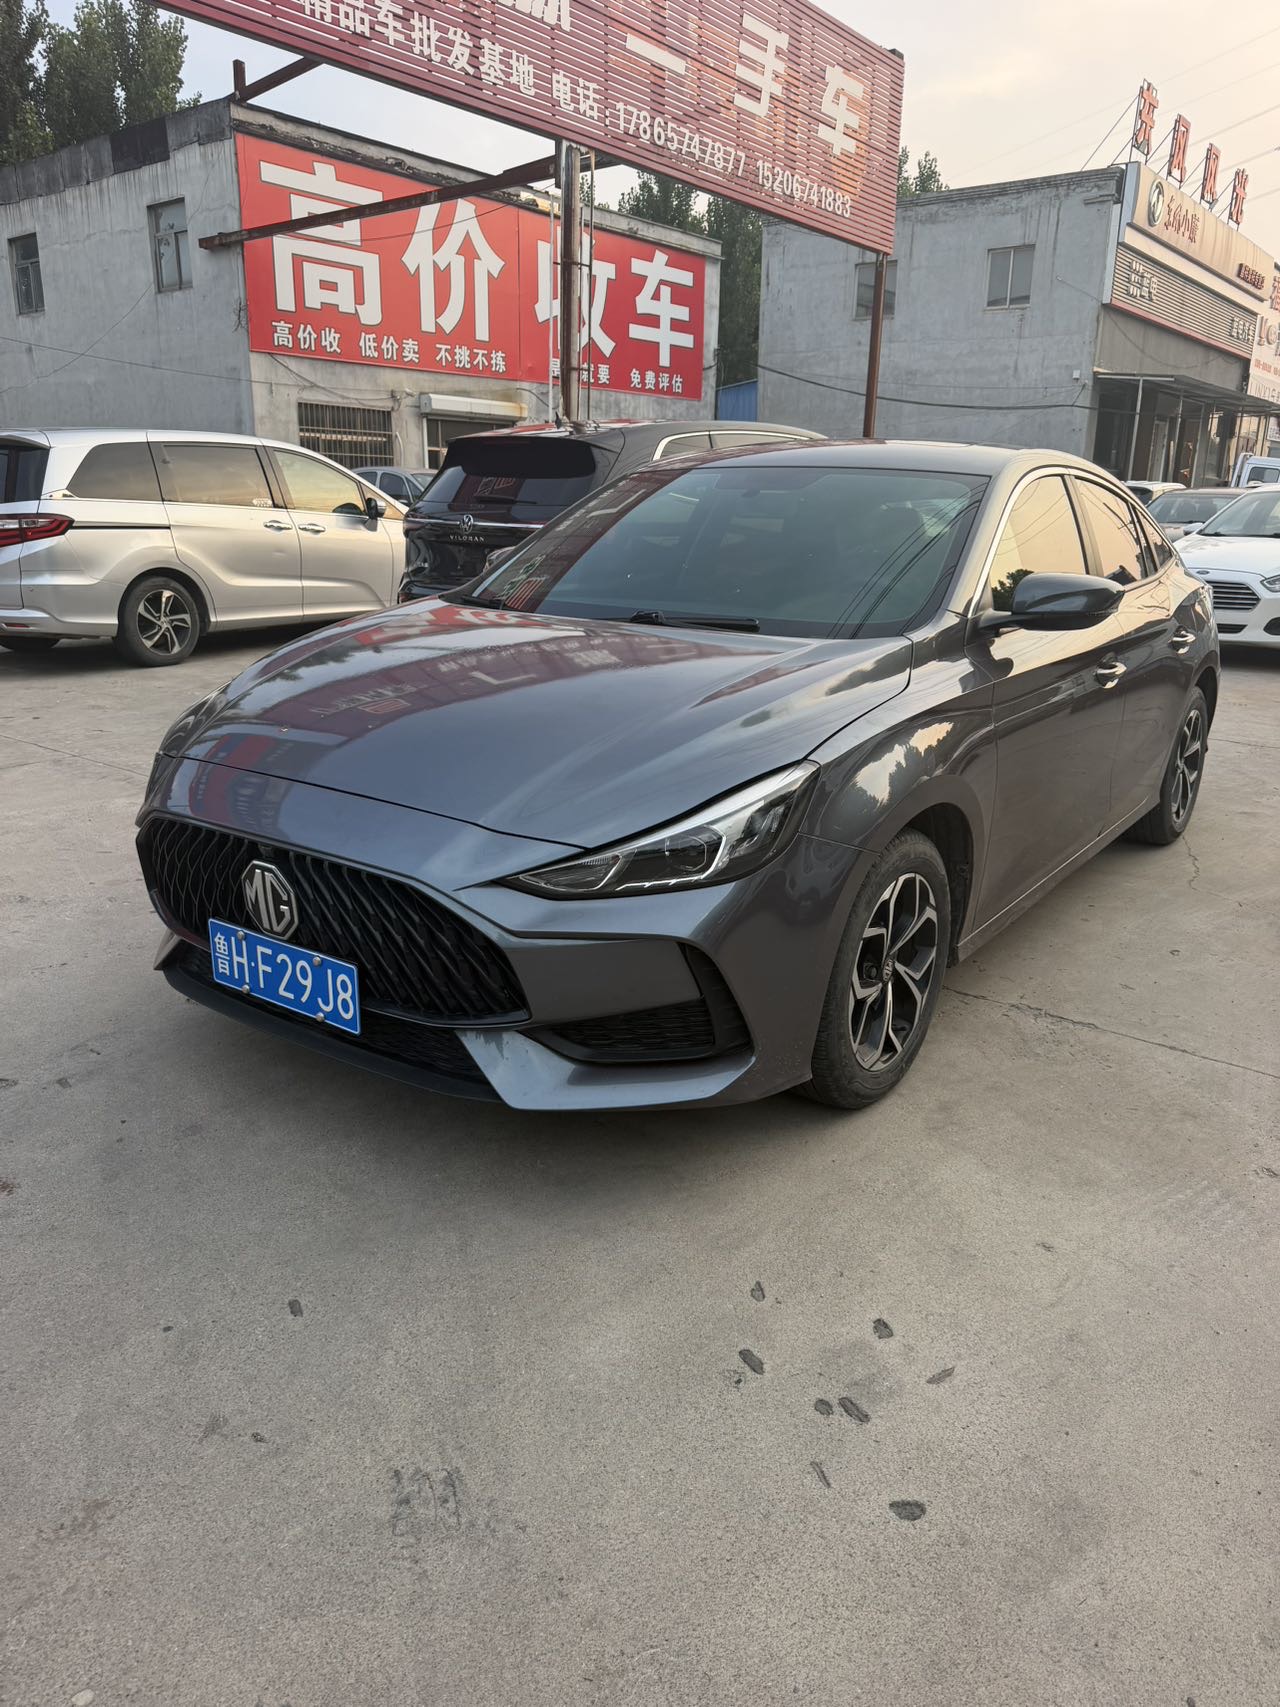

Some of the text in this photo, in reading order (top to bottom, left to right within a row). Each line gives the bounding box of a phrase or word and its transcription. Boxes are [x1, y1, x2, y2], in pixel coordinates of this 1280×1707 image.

[756, 158, 851, 219] 15206741883
[259, 161, 695, 368] 高价收车
[272, 320, 683, 393] 高价收 低价卖 不挑不拣 是就要 免费评估
[244, 867, 293, 934] MG
